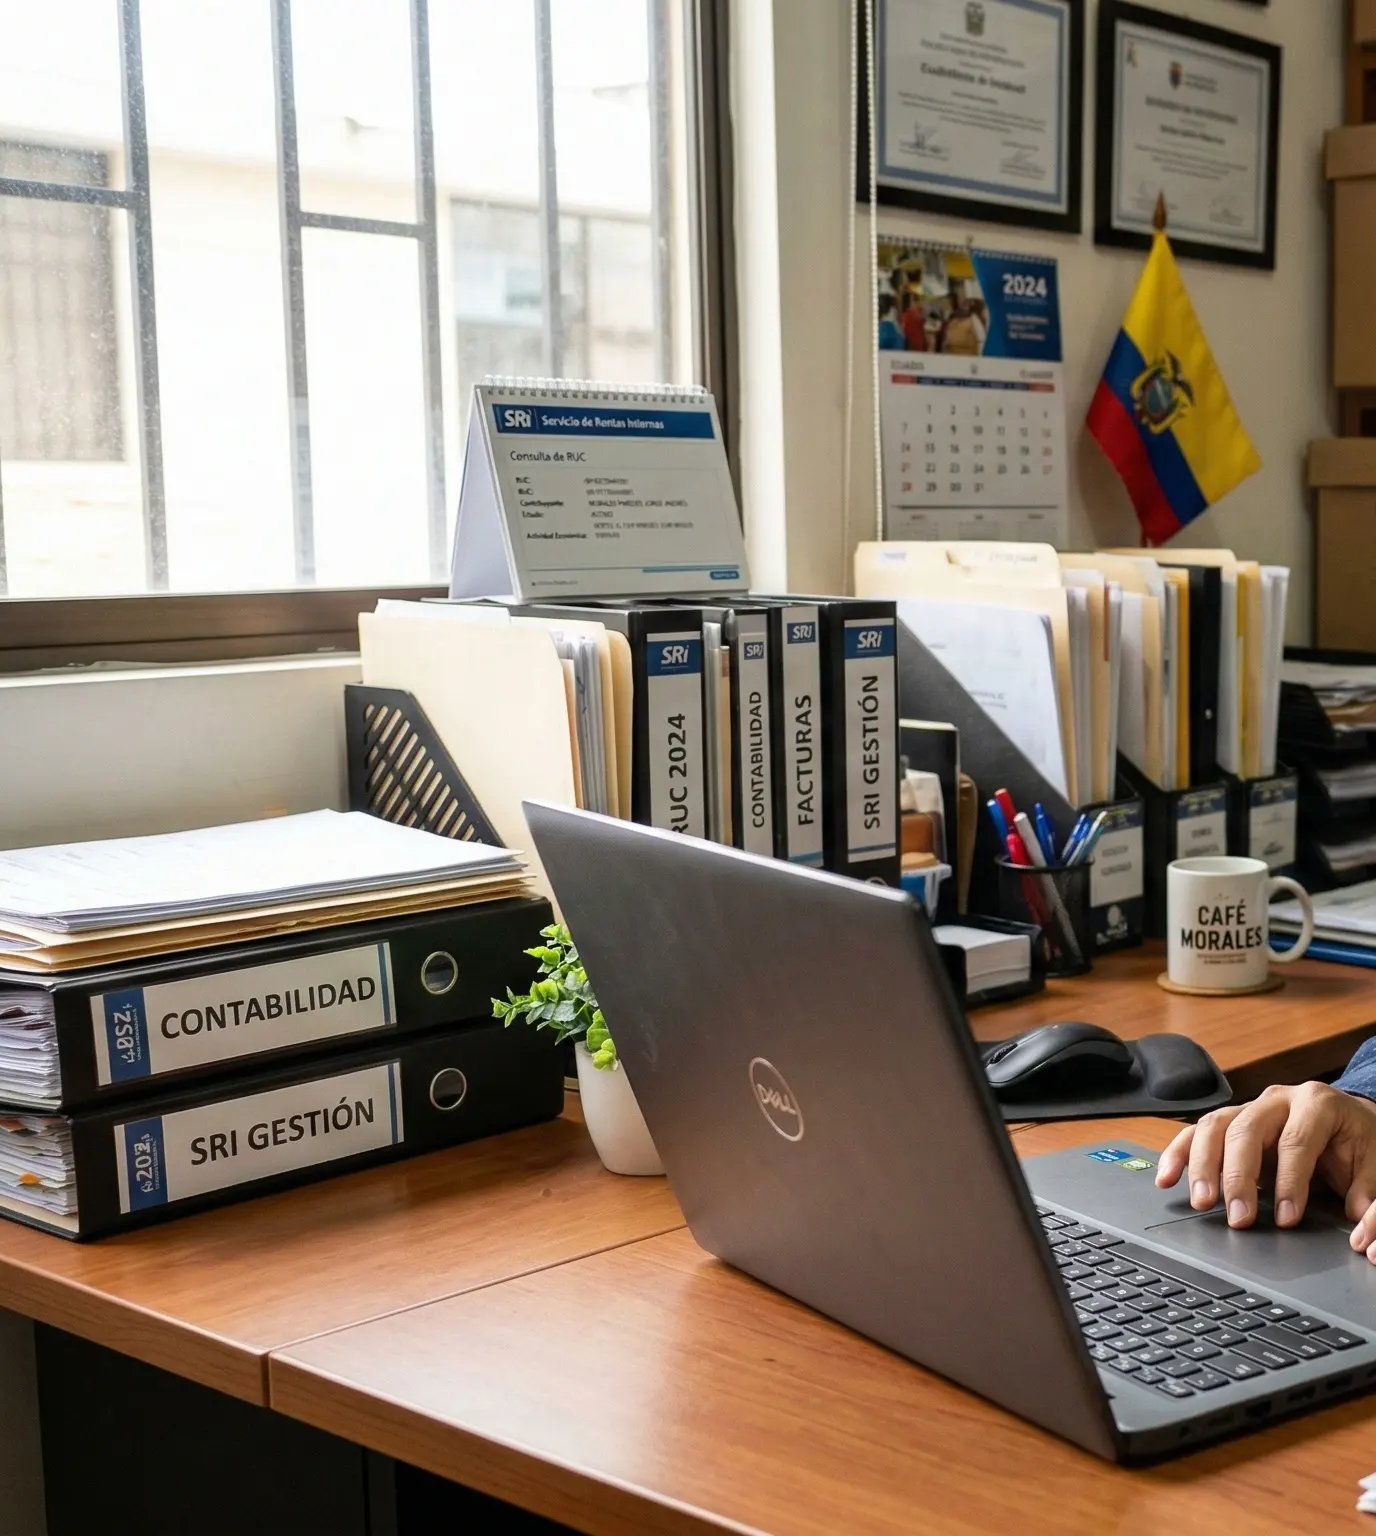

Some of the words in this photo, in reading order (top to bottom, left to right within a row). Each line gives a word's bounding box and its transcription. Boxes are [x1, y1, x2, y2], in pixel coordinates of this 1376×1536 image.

[1003, 273, 1048, 298] 2024
[542, 414, 580, 427] Servicio
[581, 416, 594, 427] de
[554, 451, 565, 462] de
[567, 452, 586, 462] RUC
[668, 713, 687, 779] 2024
[858, 675, 880, 784] GESTIÓN
[748, 691, 765, 828] CONTABILIDAD
[796, 694, 814, 826] FACTURAS
[864, 793, 880, 830] SRI
[1198, 898, 1247, 926] CAFÉ
[1181, 926, 1263, 950] MORALES
[160, 975, 377, 1040] CONTABILIDAD
[189, 1129, 239, 1167] SRI
[246, 1097, 377, 1152] GESTIÓN
